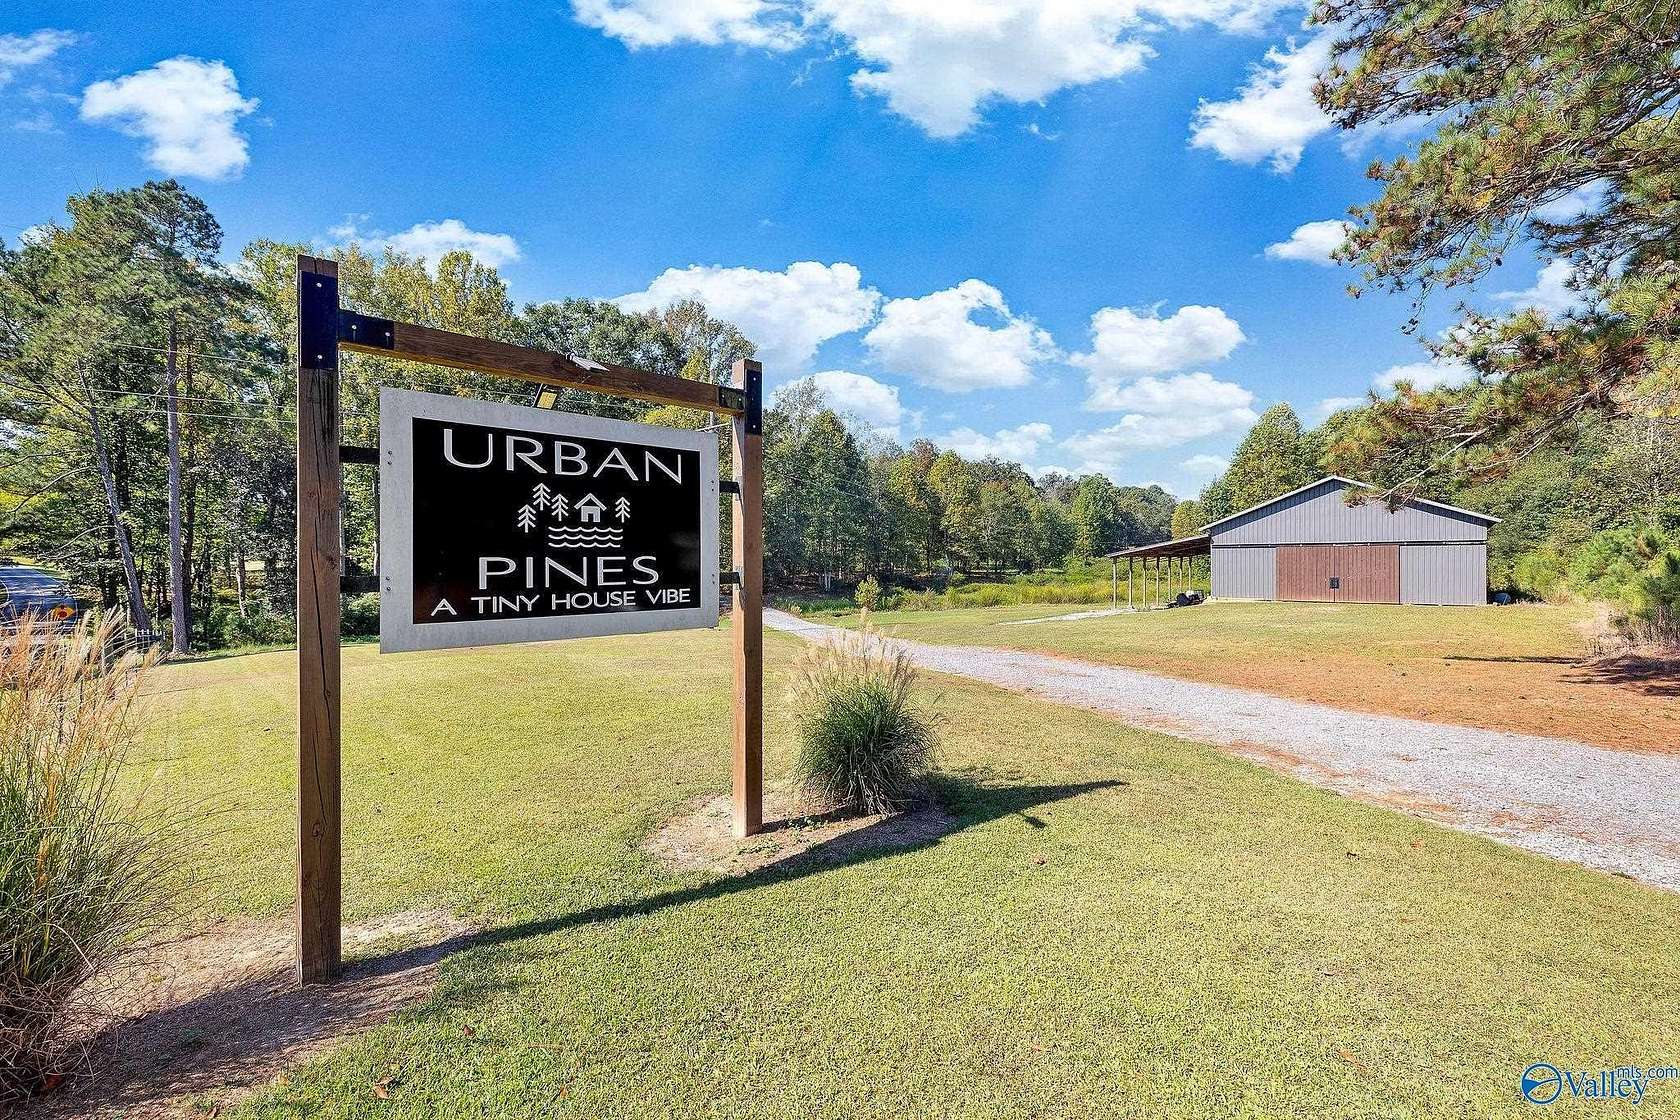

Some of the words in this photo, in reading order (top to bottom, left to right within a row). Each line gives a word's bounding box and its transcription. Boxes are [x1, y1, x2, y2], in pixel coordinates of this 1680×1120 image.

[443, 428, 682, 485] URBAN
[478, 556, 659, 590] PINES
[431, 598, 457, 617] A
[470, 594, 540, 614] TINY
[551, 590, 637, 610] HOUSE
[645, 588, 691, 606] VIBE
